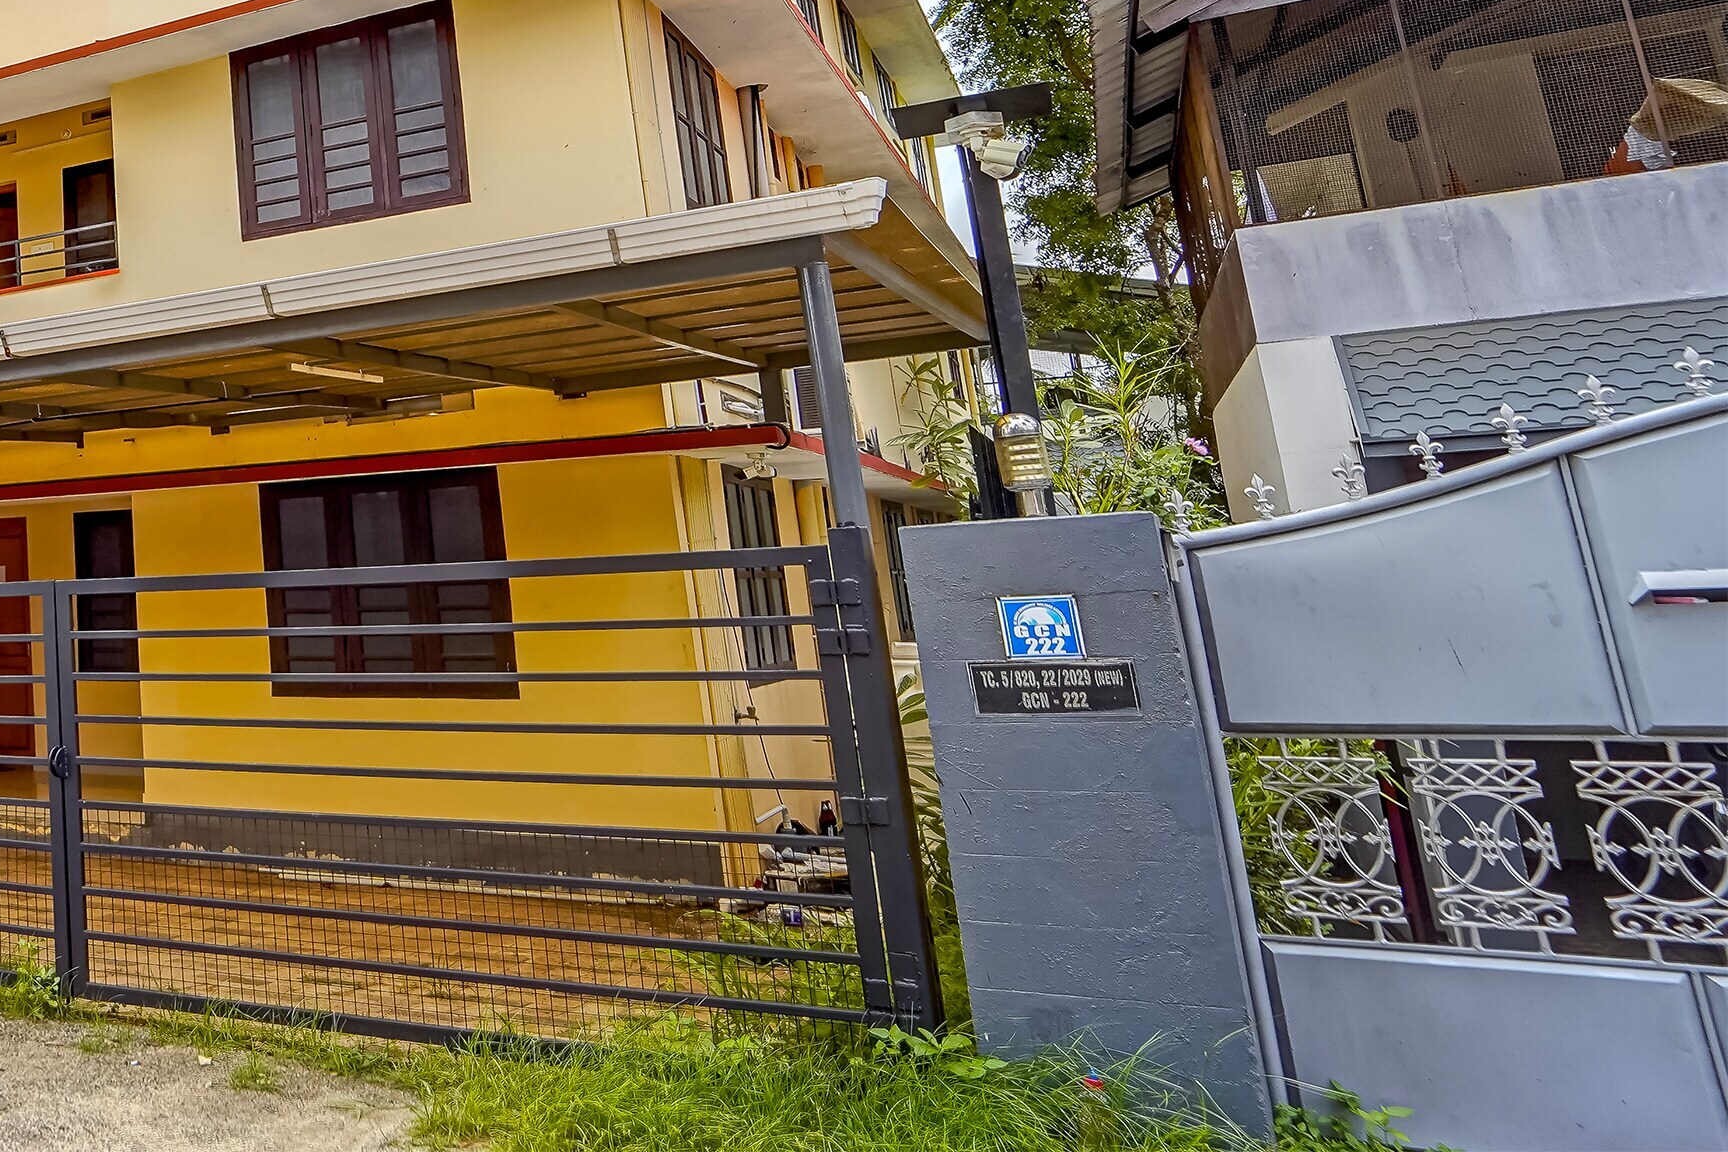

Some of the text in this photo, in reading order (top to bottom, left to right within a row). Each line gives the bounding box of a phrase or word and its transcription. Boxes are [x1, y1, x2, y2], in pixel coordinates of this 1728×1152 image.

[1025, 637, 1067, 654] 222
[1094, 669, 1124, 688] (NEW)
[1022, 691, 1050, 709] GCN
[1062, 691, 1089, 708] 222
